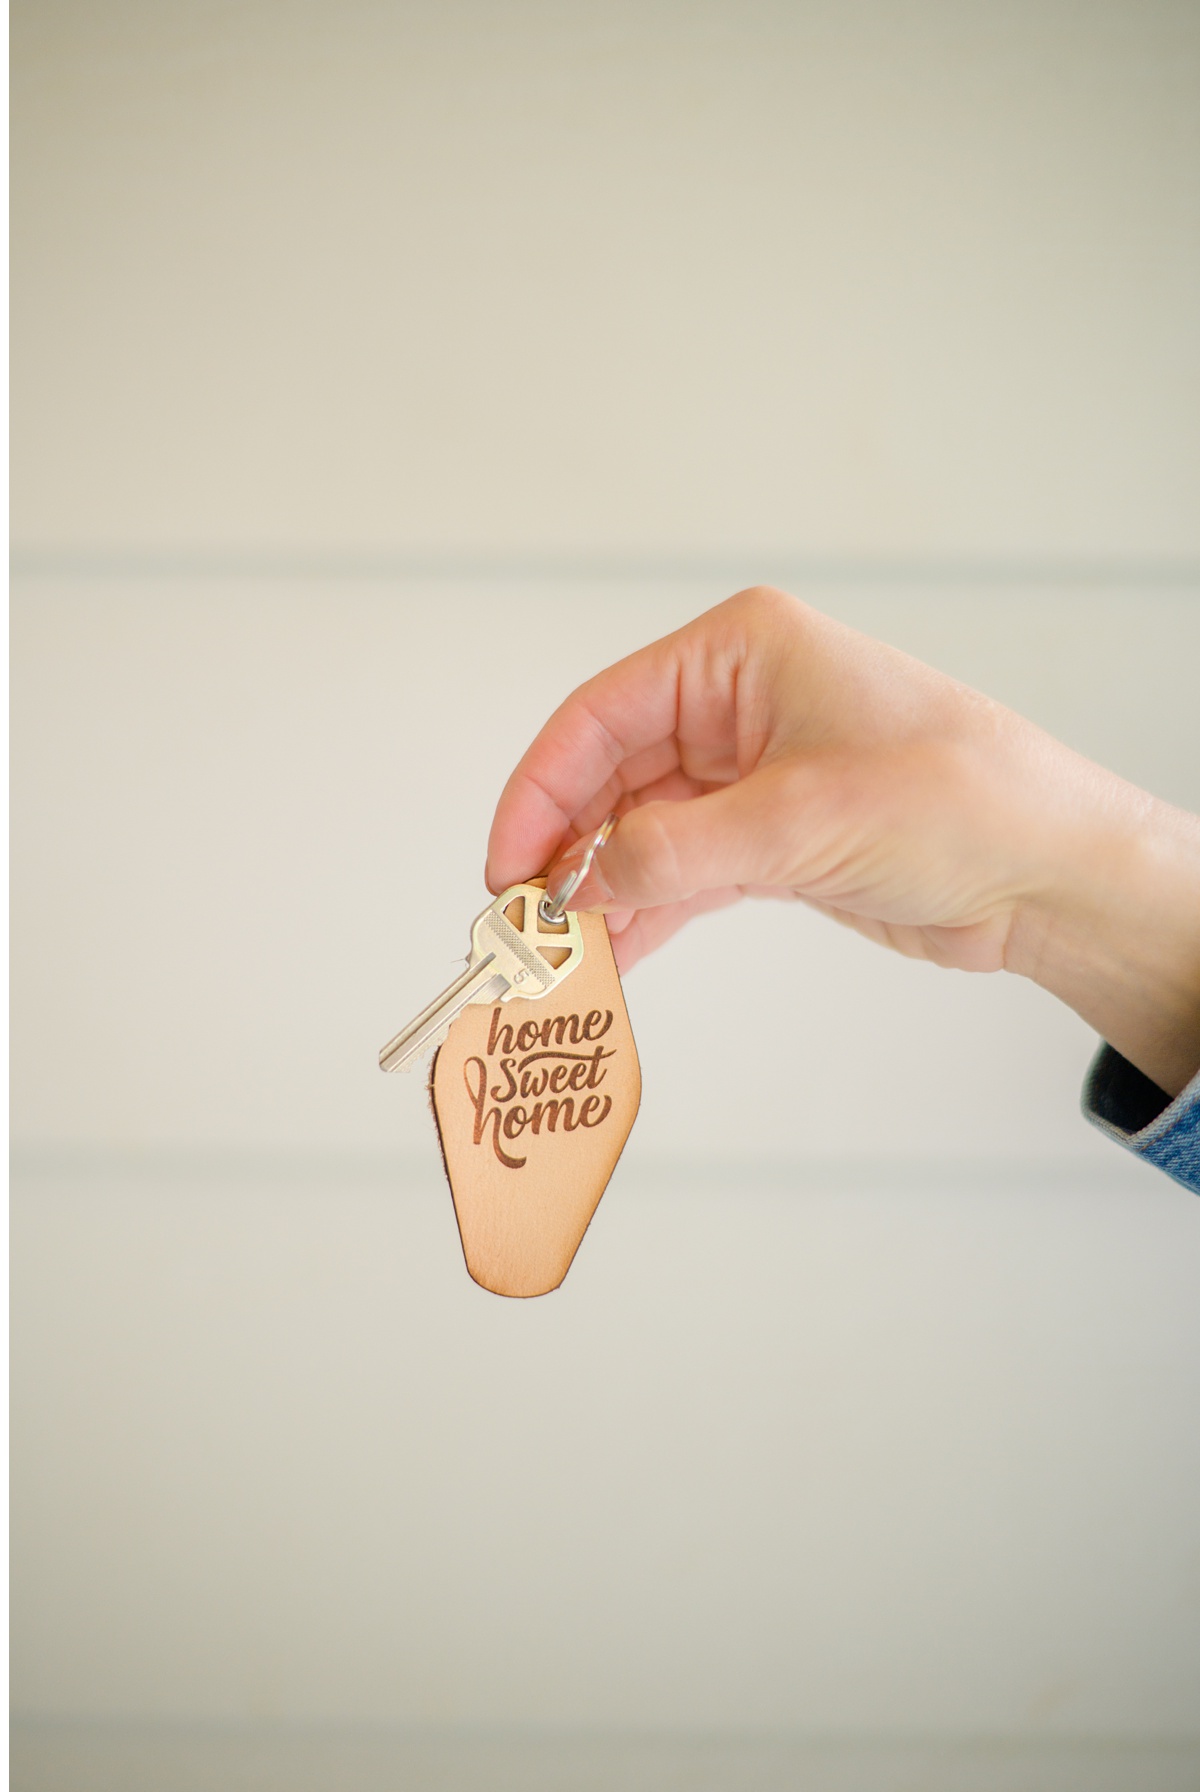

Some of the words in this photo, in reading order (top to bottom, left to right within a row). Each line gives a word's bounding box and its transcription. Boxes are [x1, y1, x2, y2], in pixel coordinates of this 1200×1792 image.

[513, 968, 530, 985] 5
[486, 1007, 613, 1056] home
[463, 1056, 613, 1169] home
